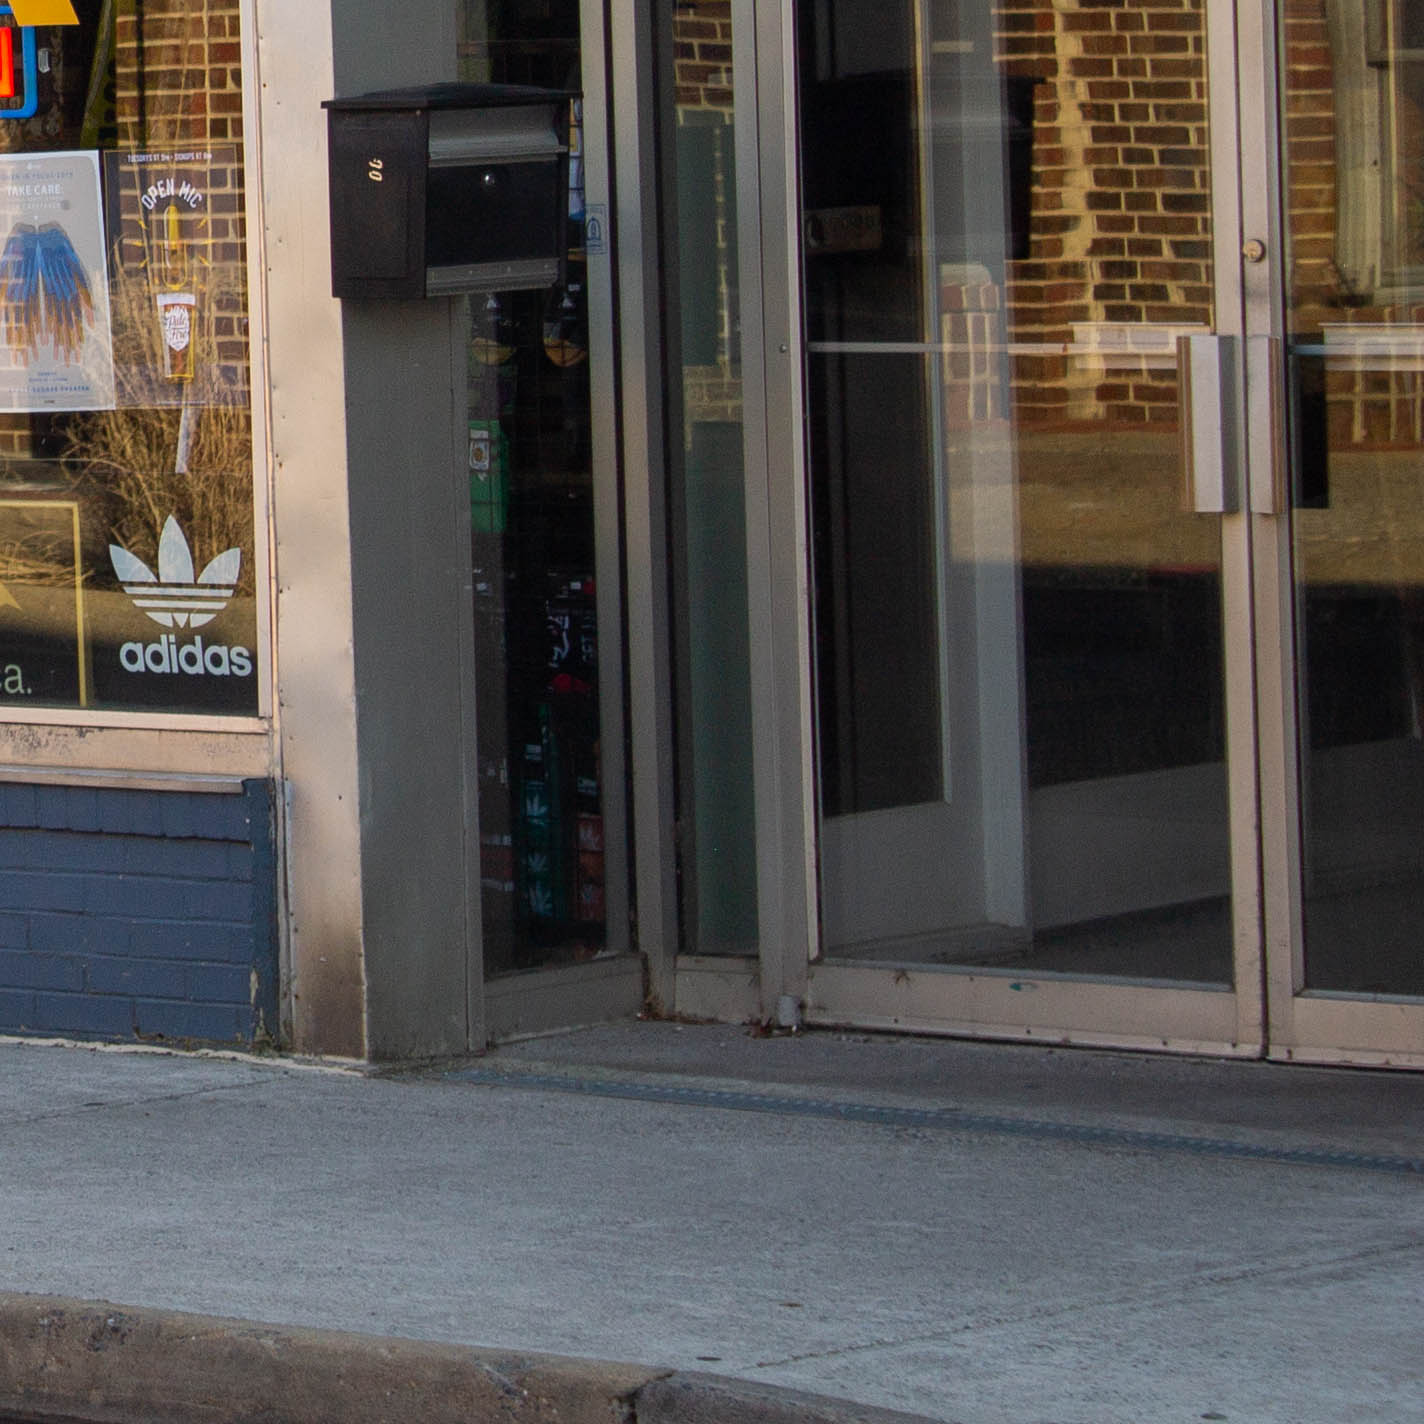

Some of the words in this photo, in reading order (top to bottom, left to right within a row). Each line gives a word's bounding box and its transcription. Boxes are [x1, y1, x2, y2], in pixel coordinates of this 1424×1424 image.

[7, 184, 32, 197] TAKE
[141, 178, 175, 210] OPEN
[179, 180, 202, 208] MIC
[119, 634, 252, 676] adidas
